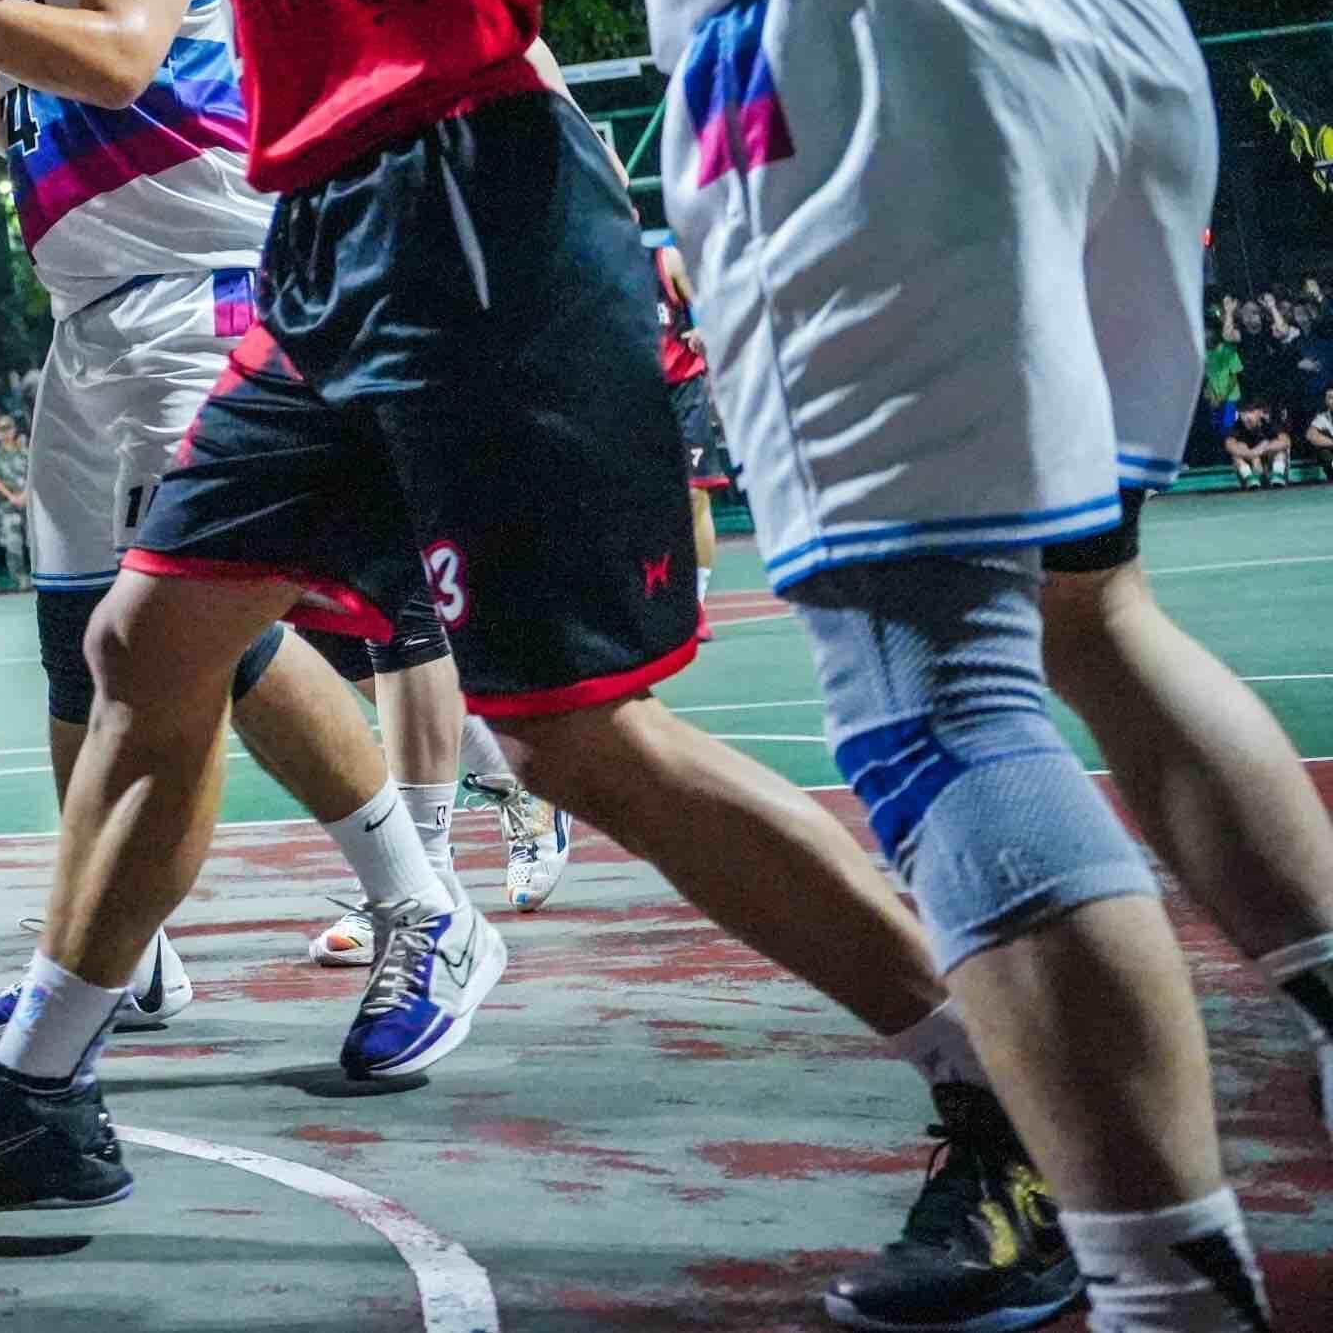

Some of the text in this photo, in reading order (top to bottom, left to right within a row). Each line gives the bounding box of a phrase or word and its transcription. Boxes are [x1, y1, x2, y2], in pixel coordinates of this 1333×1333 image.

[0, 84, 41, 156] 4
[690, 447, 703, 468] 7
[124, 484, 161, 528] 1
[419, 547, 464, 622] 3
